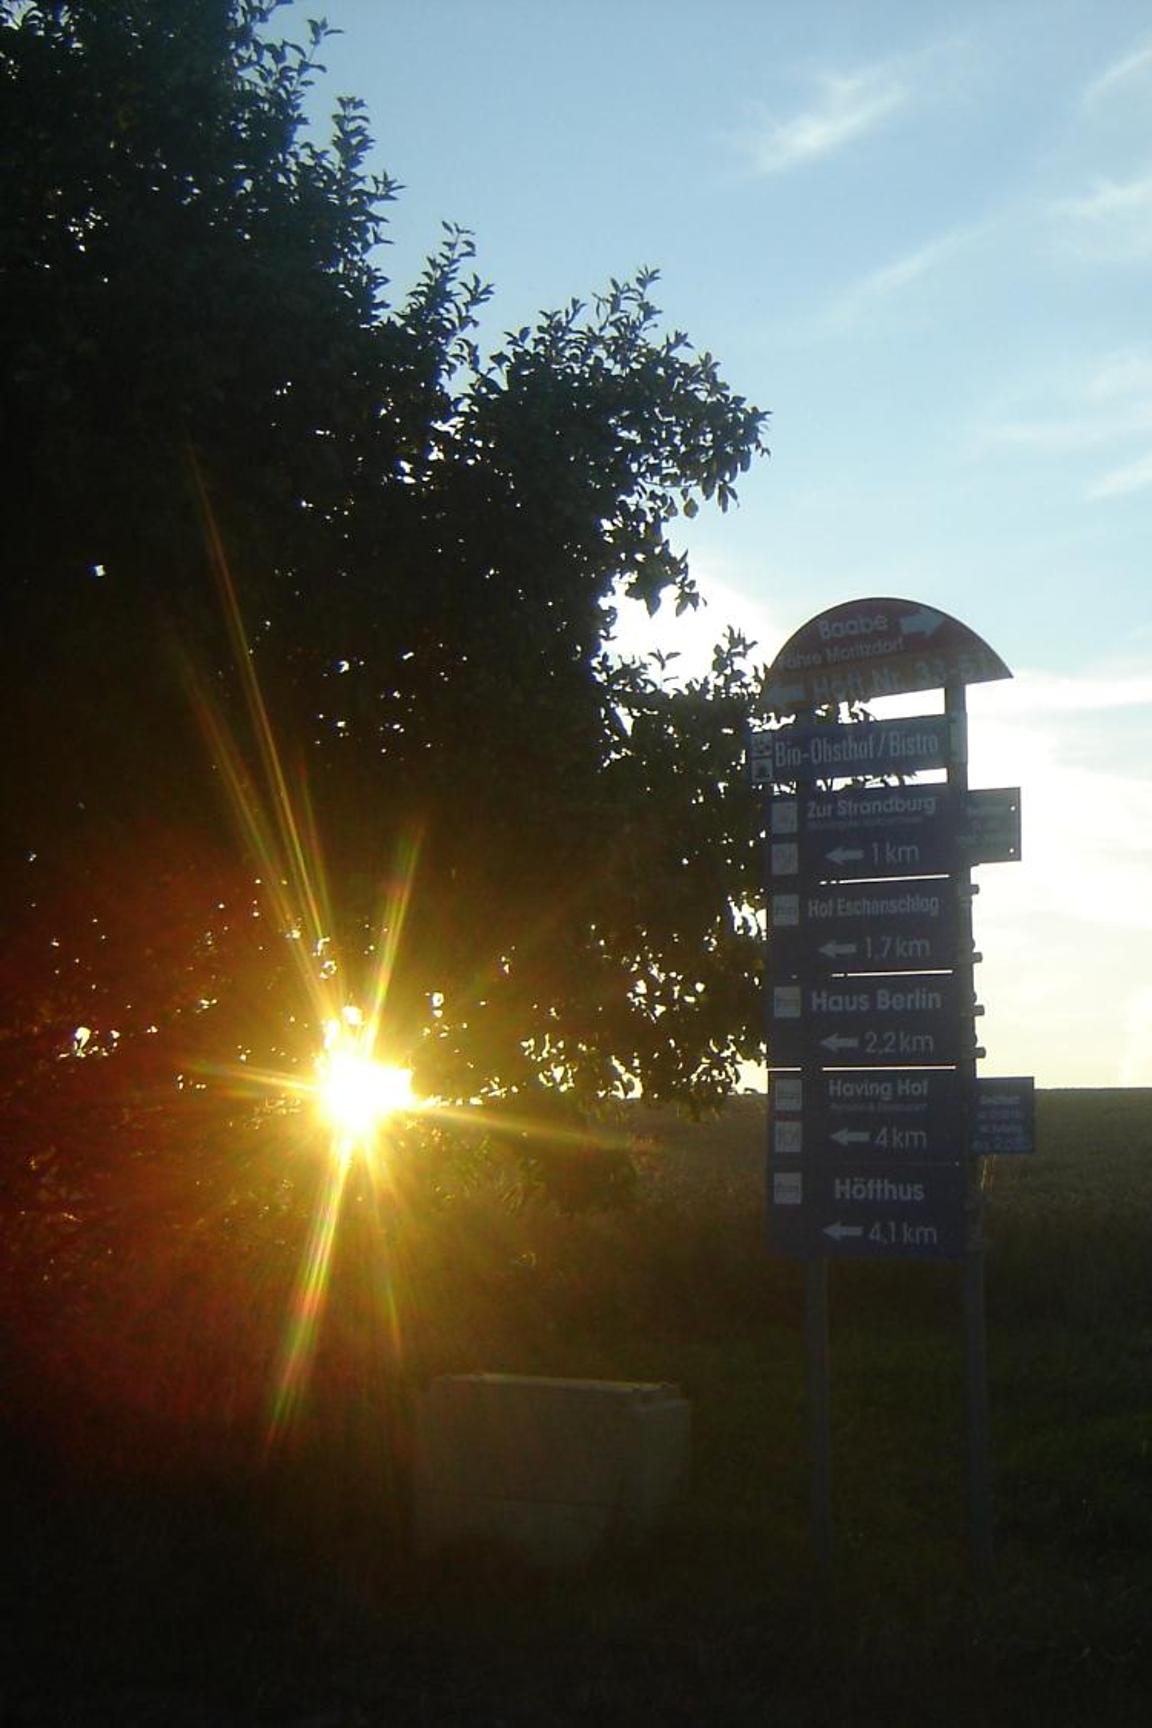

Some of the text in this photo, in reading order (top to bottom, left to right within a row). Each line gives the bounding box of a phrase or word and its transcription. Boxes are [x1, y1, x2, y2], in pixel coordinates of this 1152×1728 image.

[818, 614, 889, 641] Baabe
[807, 796, 937, 819] Zur Strandburg
[872, 841, 919, 865] 1 km
[808, 897, 833, 918] Hof
[811, 987, 942, 1013] Haus Berlin
[828, 1078, 929, 1101] Having Hof
[834, 1177, 925, 1201] Höfthus
